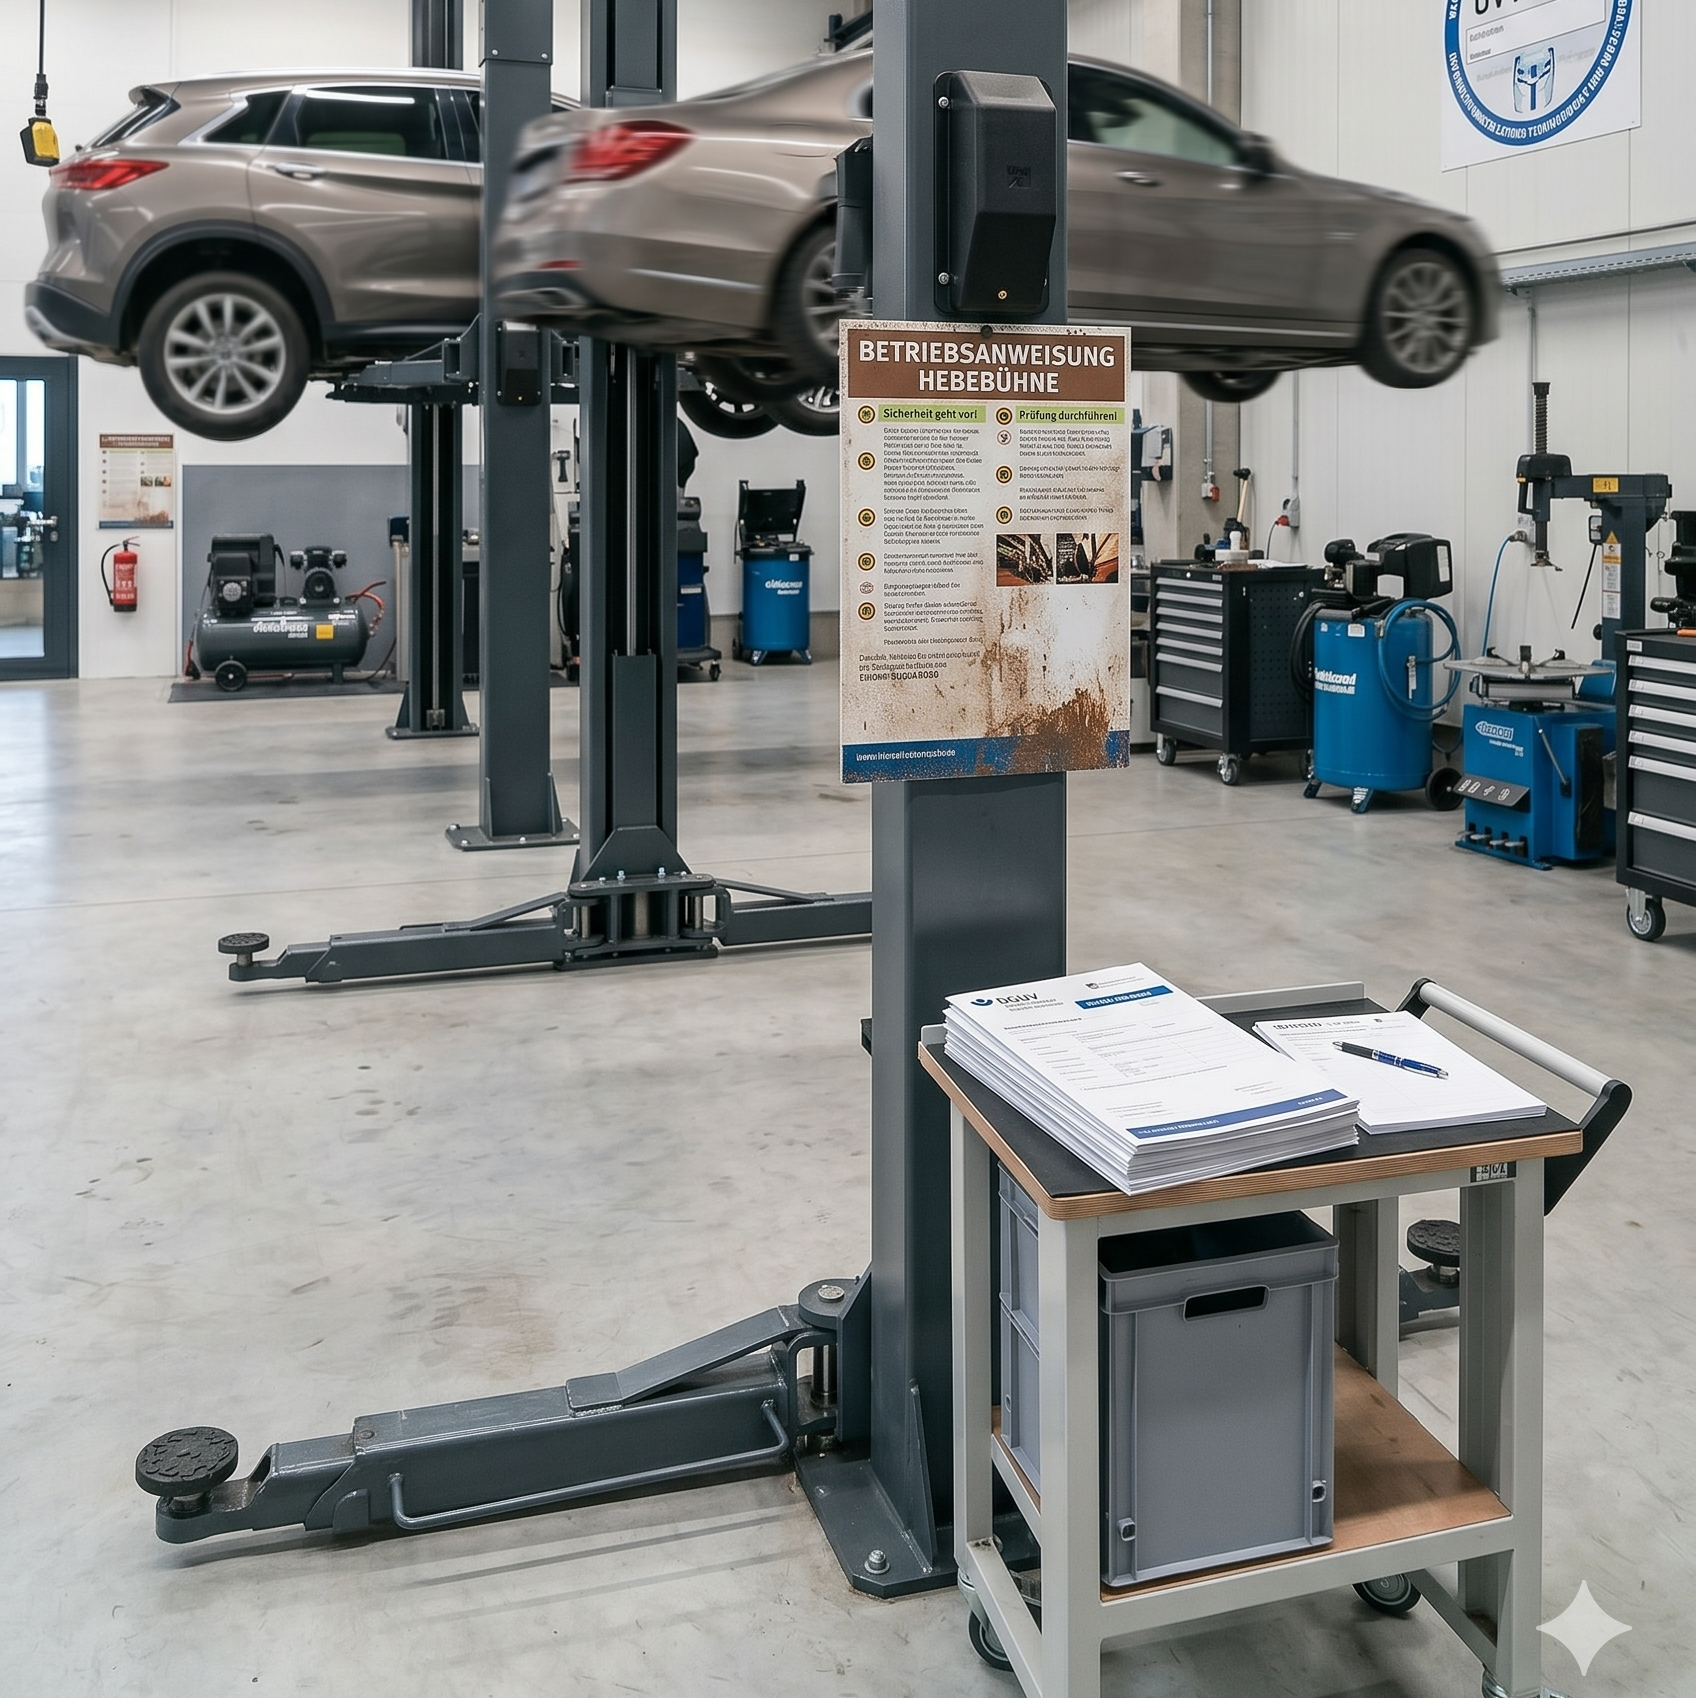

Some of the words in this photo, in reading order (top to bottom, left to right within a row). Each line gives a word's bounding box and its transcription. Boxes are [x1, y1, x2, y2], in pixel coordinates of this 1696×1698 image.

[859, 340, 1115, 367] BETRIEBSANWEISUNG
[919, 367, 1059, 393] HEBEBÜHNE
[883, 408, 933, 419] Sicherheit
[935, 409, 957, 421] geht
[995, 992, 1038, 1005] DGUV
